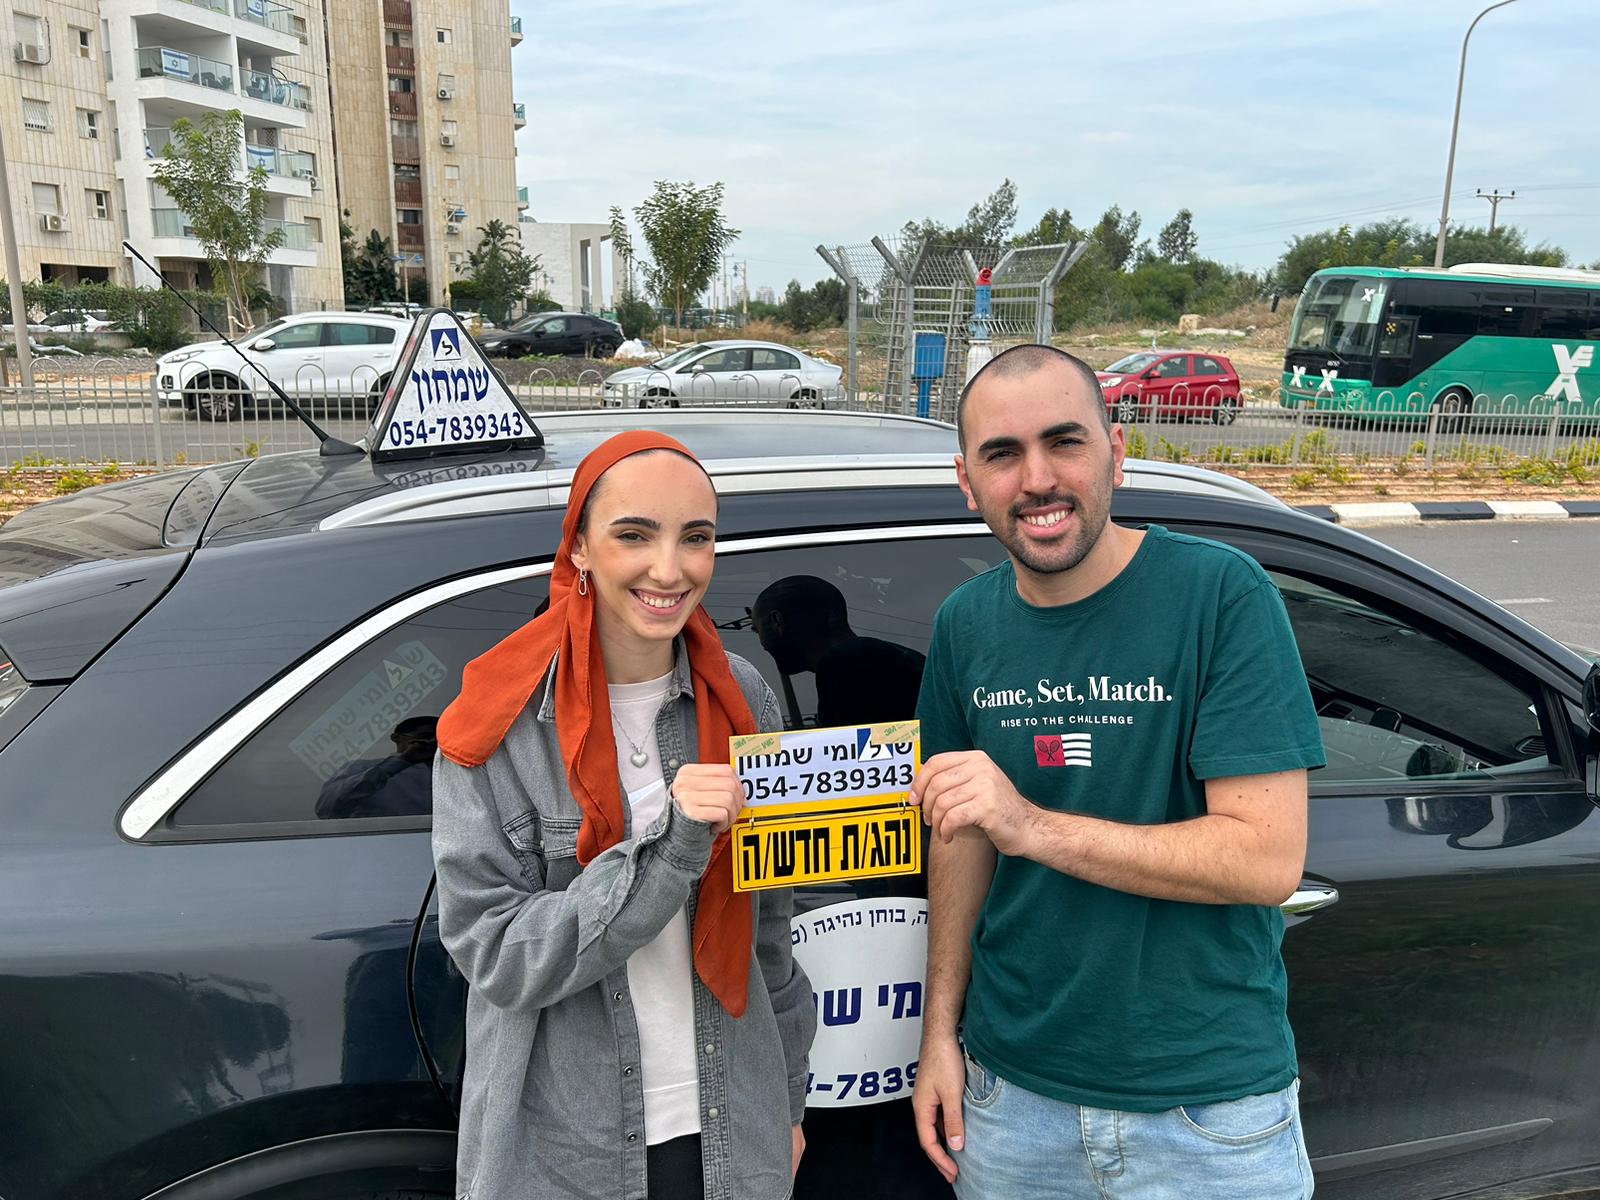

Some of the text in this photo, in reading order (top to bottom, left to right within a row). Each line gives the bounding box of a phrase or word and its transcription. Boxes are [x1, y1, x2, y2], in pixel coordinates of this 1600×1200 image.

[442, 340, 453, 356] ל
[411, 366, 489, 414] שמחון
[389, 412, 523, 447] 054-7839343
[973, 676, 1173, 709] Game, Set, Match.
[318, 662, 447, 778] 054-7839343
[1001, 715, 1134, 728] RISE TO THE CHALLENGE
[740, 763, 914, 801] 054-7839343
[743, 818, 911, 882] נהג/ת חדש/ה
[813, 911, 862, 935] נהיגה
[869, 909, 905, 927] בוחן
[878, 981, 922, 1019] מי
